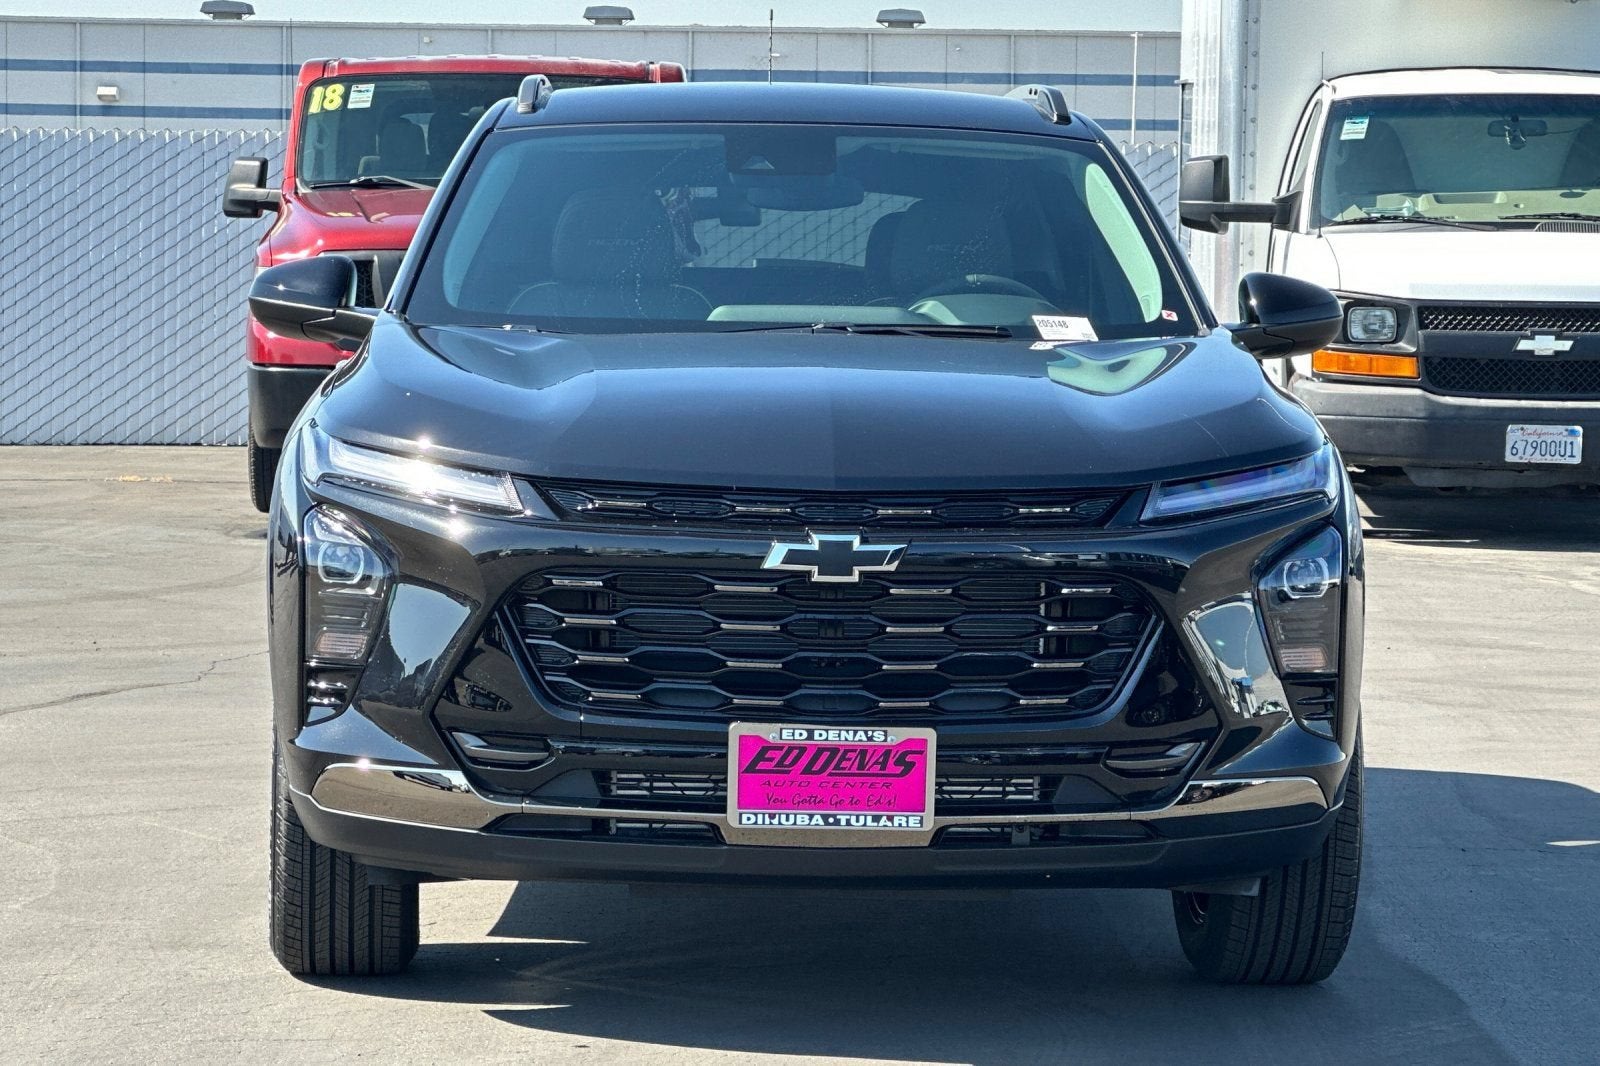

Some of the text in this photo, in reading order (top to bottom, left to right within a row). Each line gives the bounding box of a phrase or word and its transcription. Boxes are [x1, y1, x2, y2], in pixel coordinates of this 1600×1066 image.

[308, 83, 345, 114] 18
[1521, 427, 1563, 439] California
[1510, 439, 1576, 458] 67900U1
[781, 729, 885, 742] ED DENA'S
[741, 745, 925, 778] ED DENA'S
[760, 780, 893, 789] AUTO CENTER
[766, 792, 897, 808] You Gotta Go to Ed's!
[741, 813, 921, 828] DINUBA TULARE
